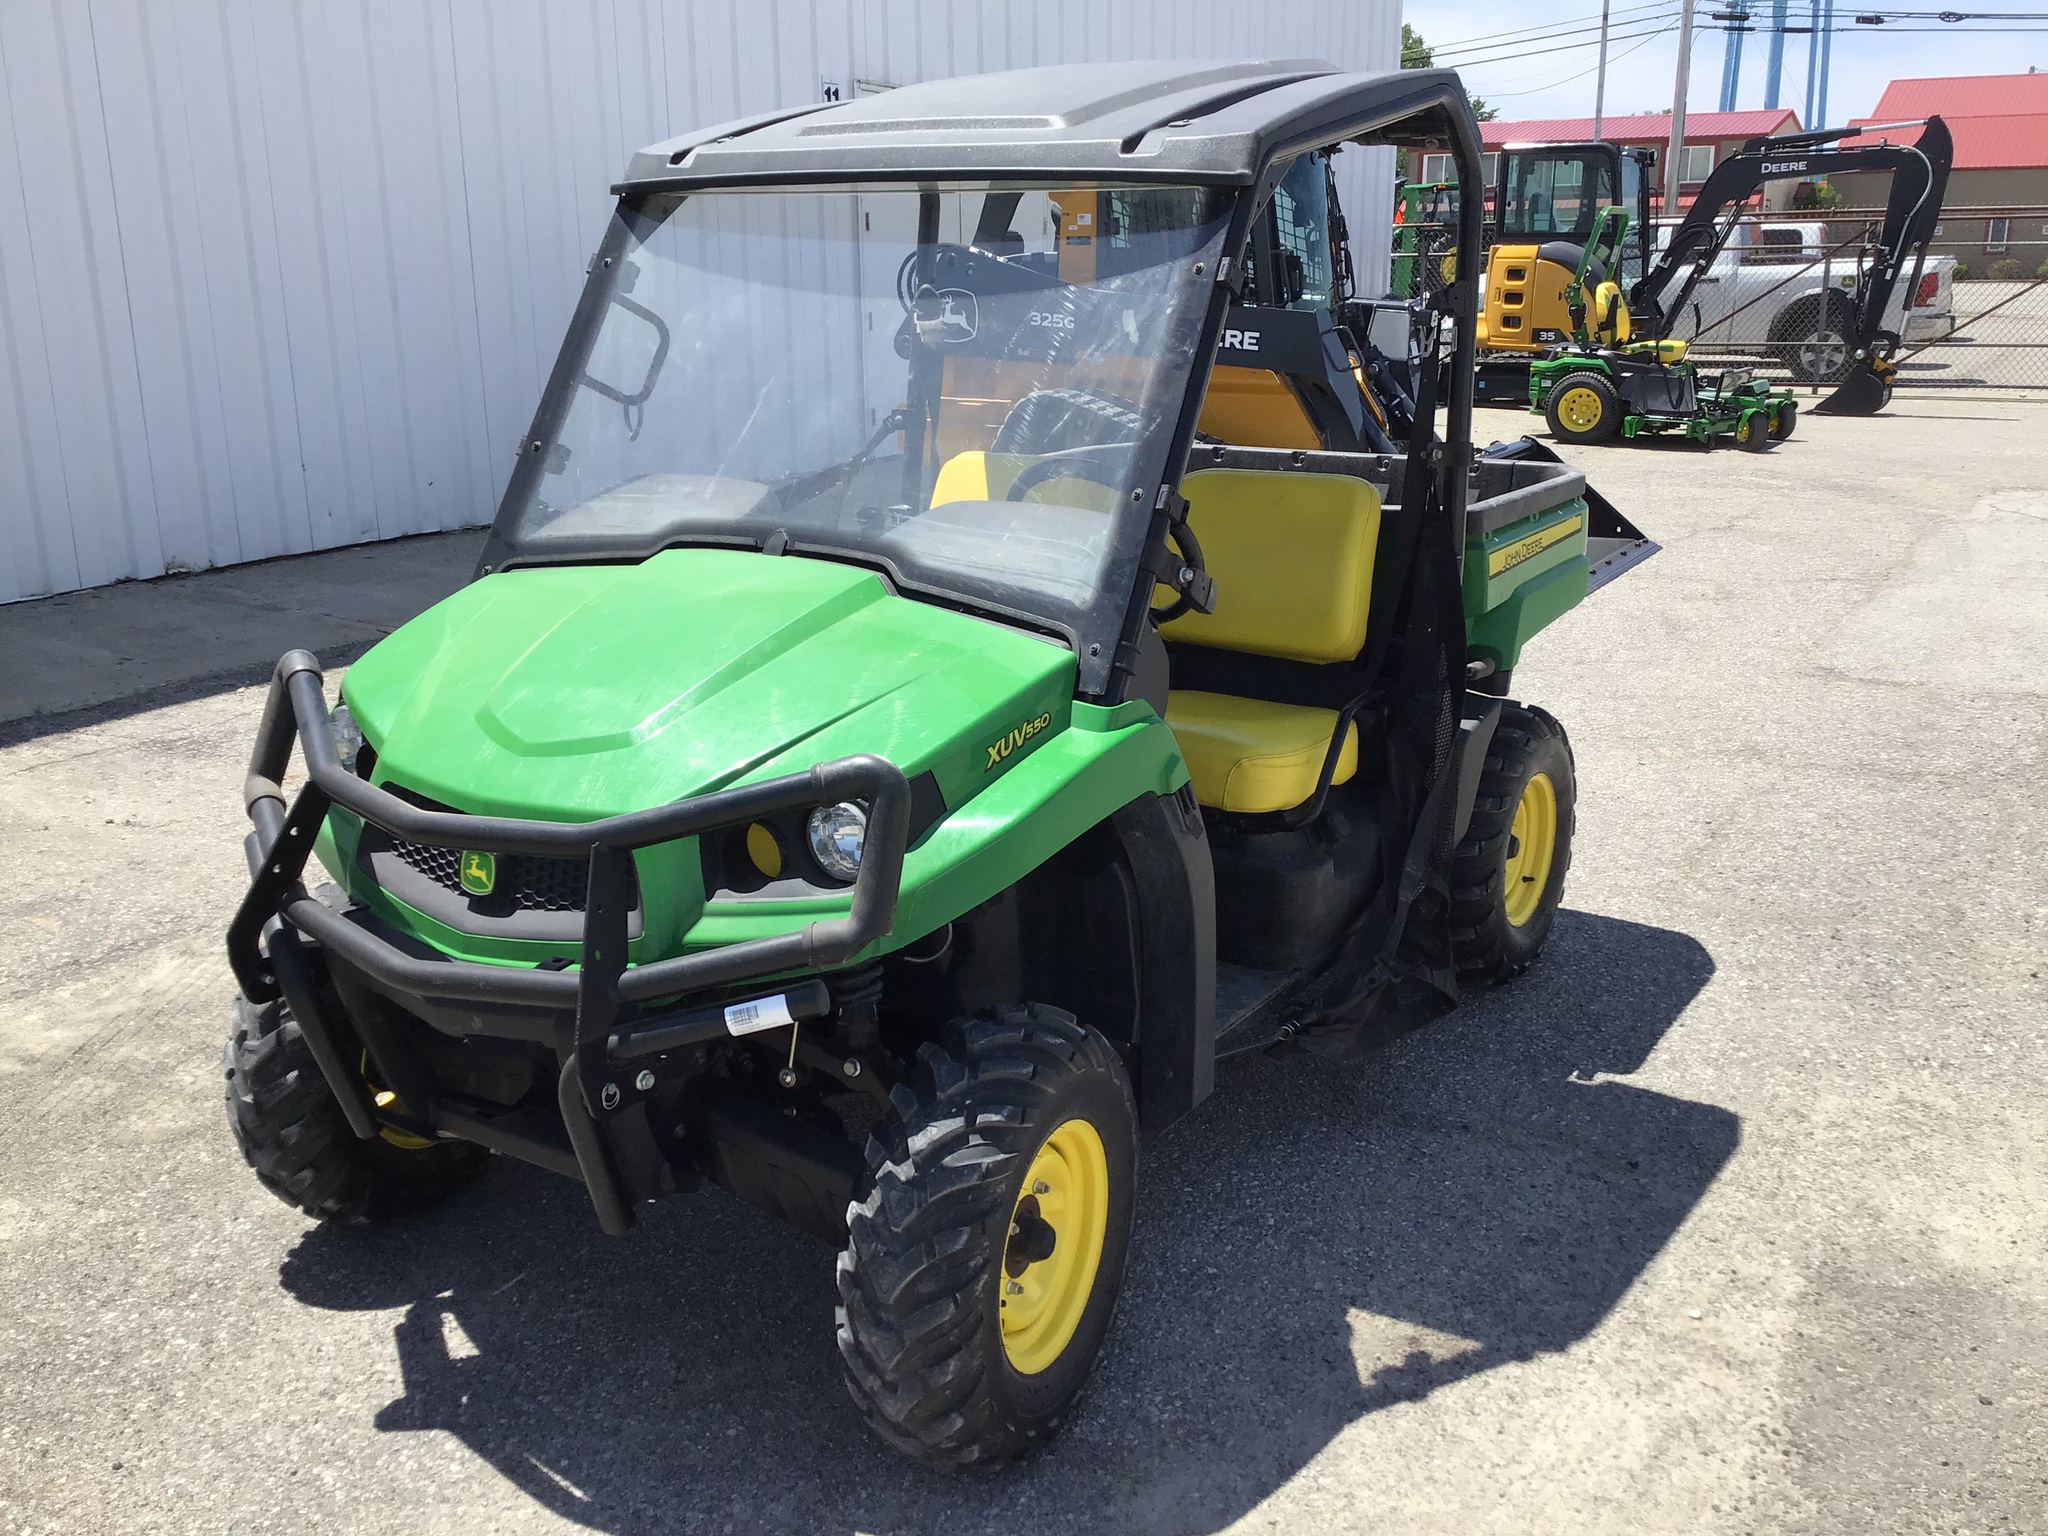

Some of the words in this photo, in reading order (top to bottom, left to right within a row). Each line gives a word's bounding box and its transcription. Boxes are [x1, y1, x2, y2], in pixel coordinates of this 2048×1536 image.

[824, 86, 840, 102] 11
[1761, 161, 1808, 174] DEERE
[1029, 311, 1075, 330] 325G
[1539, 331, 1556, 341] 35
[1502, 549, 1521, 569] JOHN
[1521, 537, 1544, 559] DEERE
